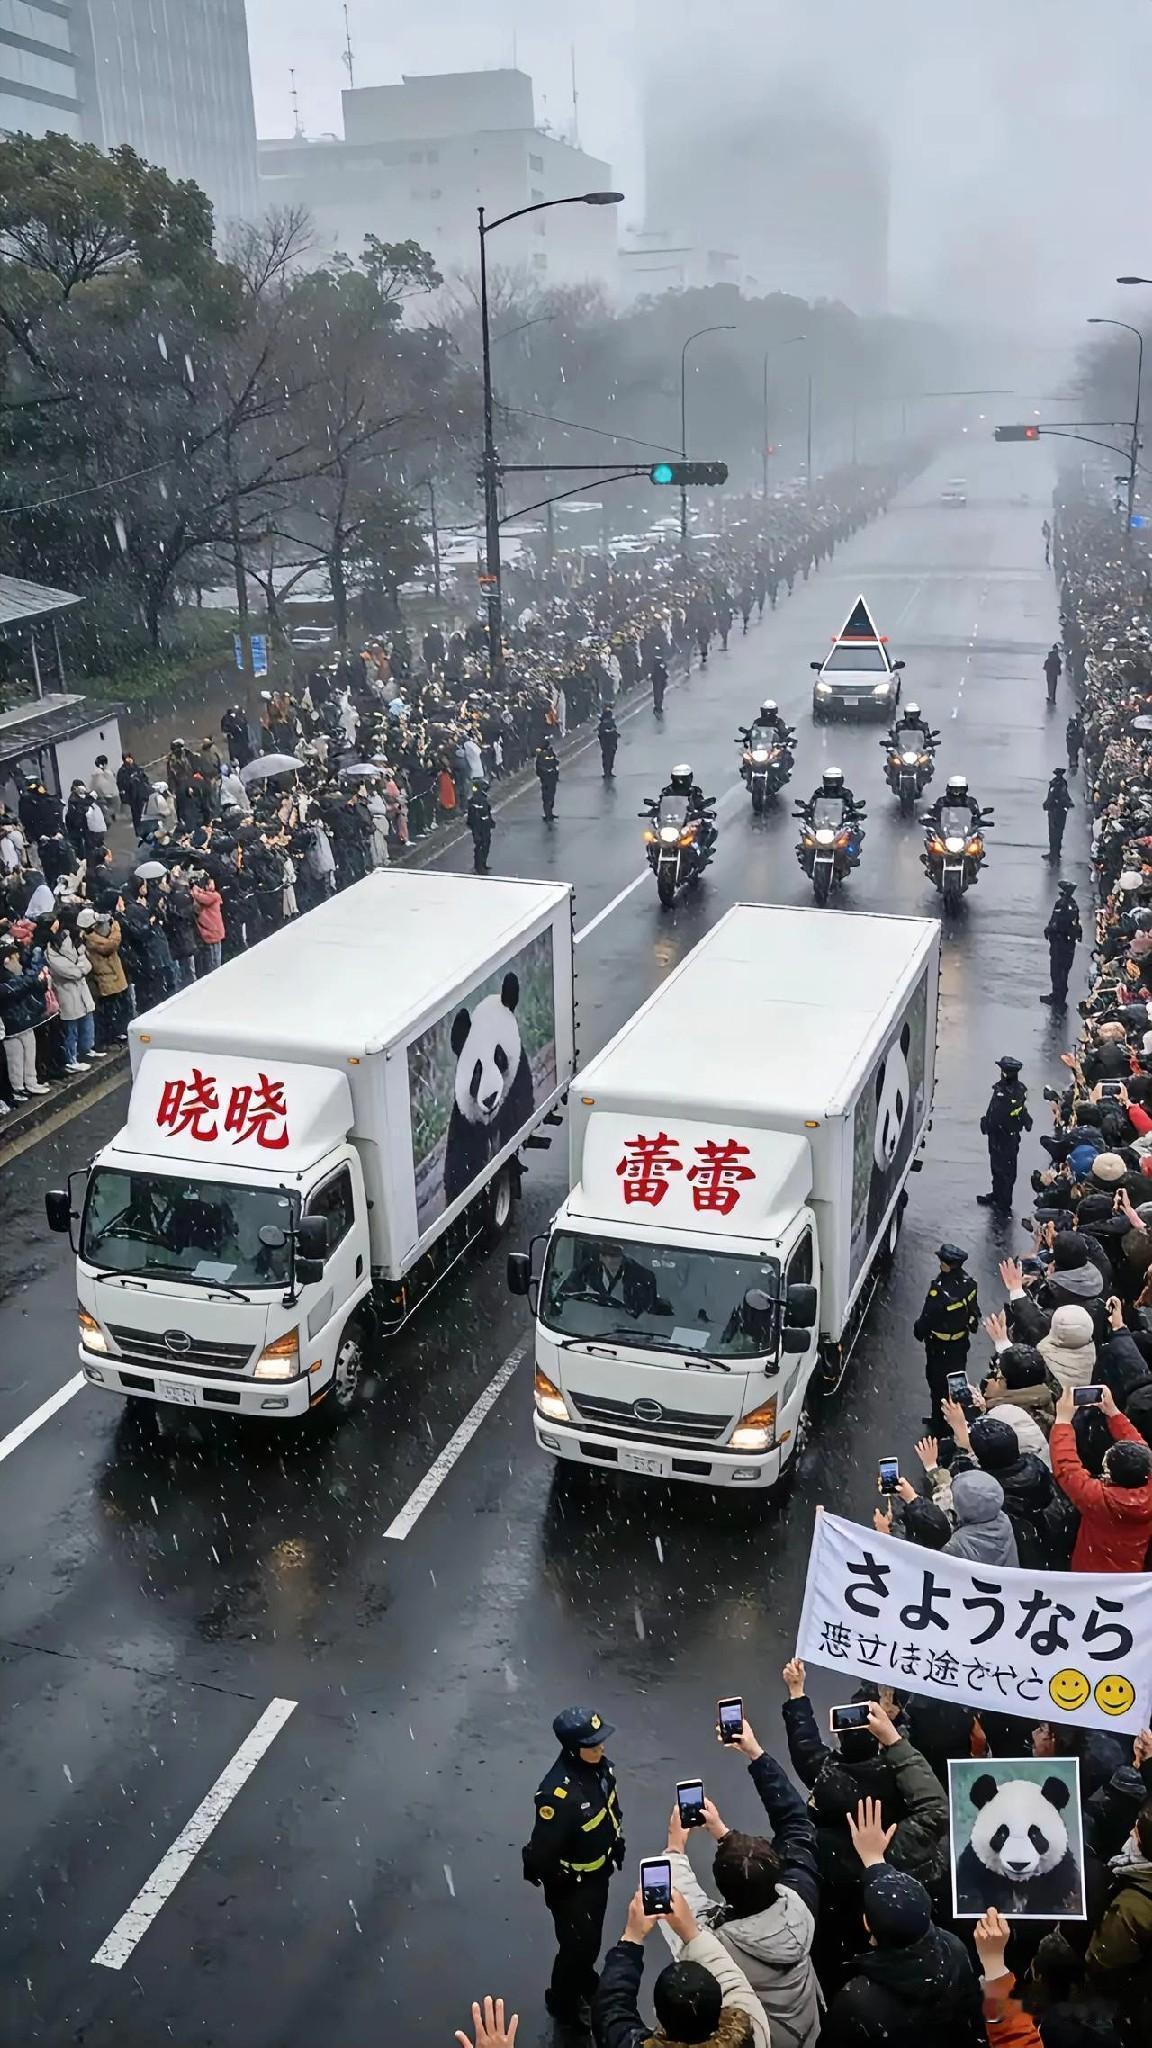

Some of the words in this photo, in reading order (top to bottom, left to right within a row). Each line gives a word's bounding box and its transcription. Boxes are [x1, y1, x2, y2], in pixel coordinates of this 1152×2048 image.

[156, 1068, 290, 1151] 晓晓
[615, 1131, 757, 1216] 蕾蕾
[844, 1551, 1134, 1662] さようなら
